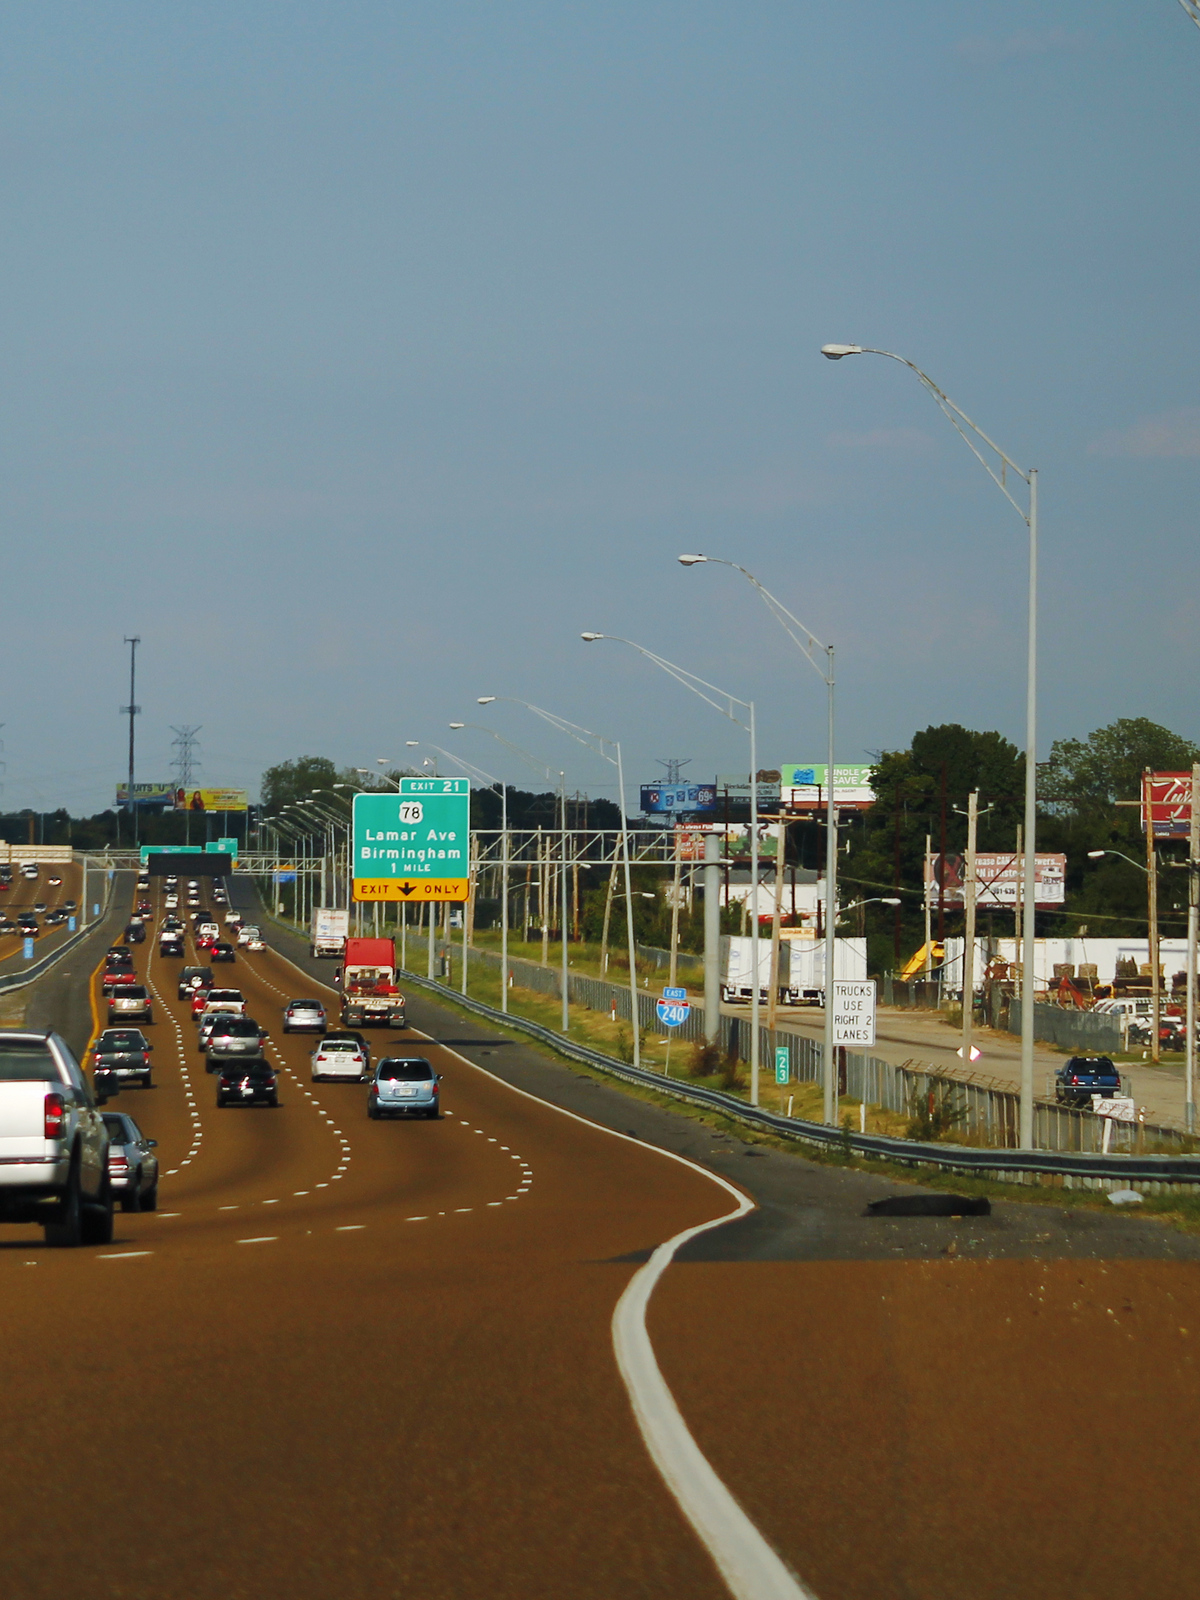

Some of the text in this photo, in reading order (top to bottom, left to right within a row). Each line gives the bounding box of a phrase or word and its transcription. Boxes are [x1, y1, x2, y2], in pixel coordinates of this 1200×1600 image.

[443, 781, 460, 792] 21
[402, 807, 420, 819] 78
[366, 829, 457, 841] Lamar Ave
[361, 847, 461, 862] Birmingham
[391, 863, 432, 873] 1 MILE
[361, 885, 460, 894] EXIT ONLY
[667, 990, 683, 998] EAST
[836, 986, 872, 996] TRUCKS
[843, 1001, 863, 1010] USE
[662, 1006, 685, 1021] 240
[834, 1015, 872, 1025] RIGHT 2
[837, 1030, 869, 1040] LANES
